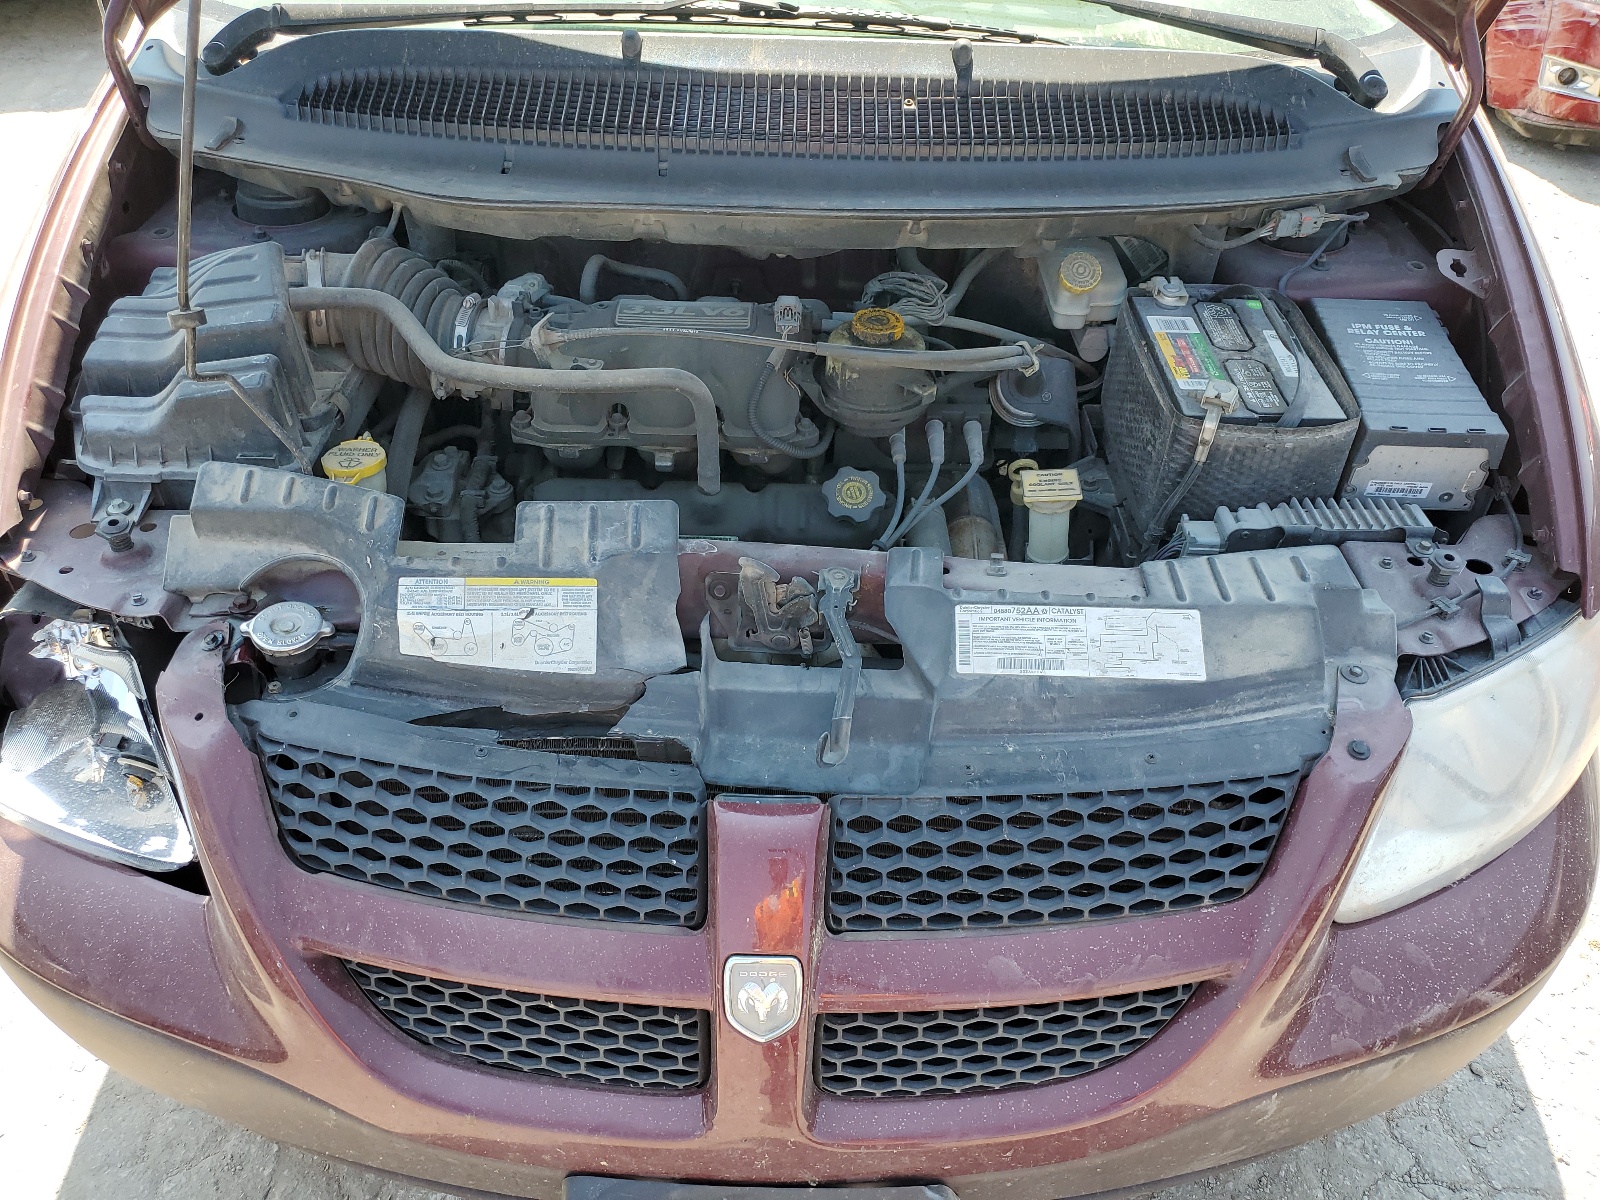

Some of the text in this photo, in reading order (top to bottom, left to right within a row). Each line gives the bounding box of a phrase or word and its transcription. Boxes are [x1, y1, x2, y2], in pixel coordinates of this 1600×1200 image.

[623, 304, 746, 317] 3.3L V6
[1347, 328, 1379, 336] RELAY
[1051, 607, 1084, 615] CATALYST
[277, 632, 307, 646] SLOWLY
